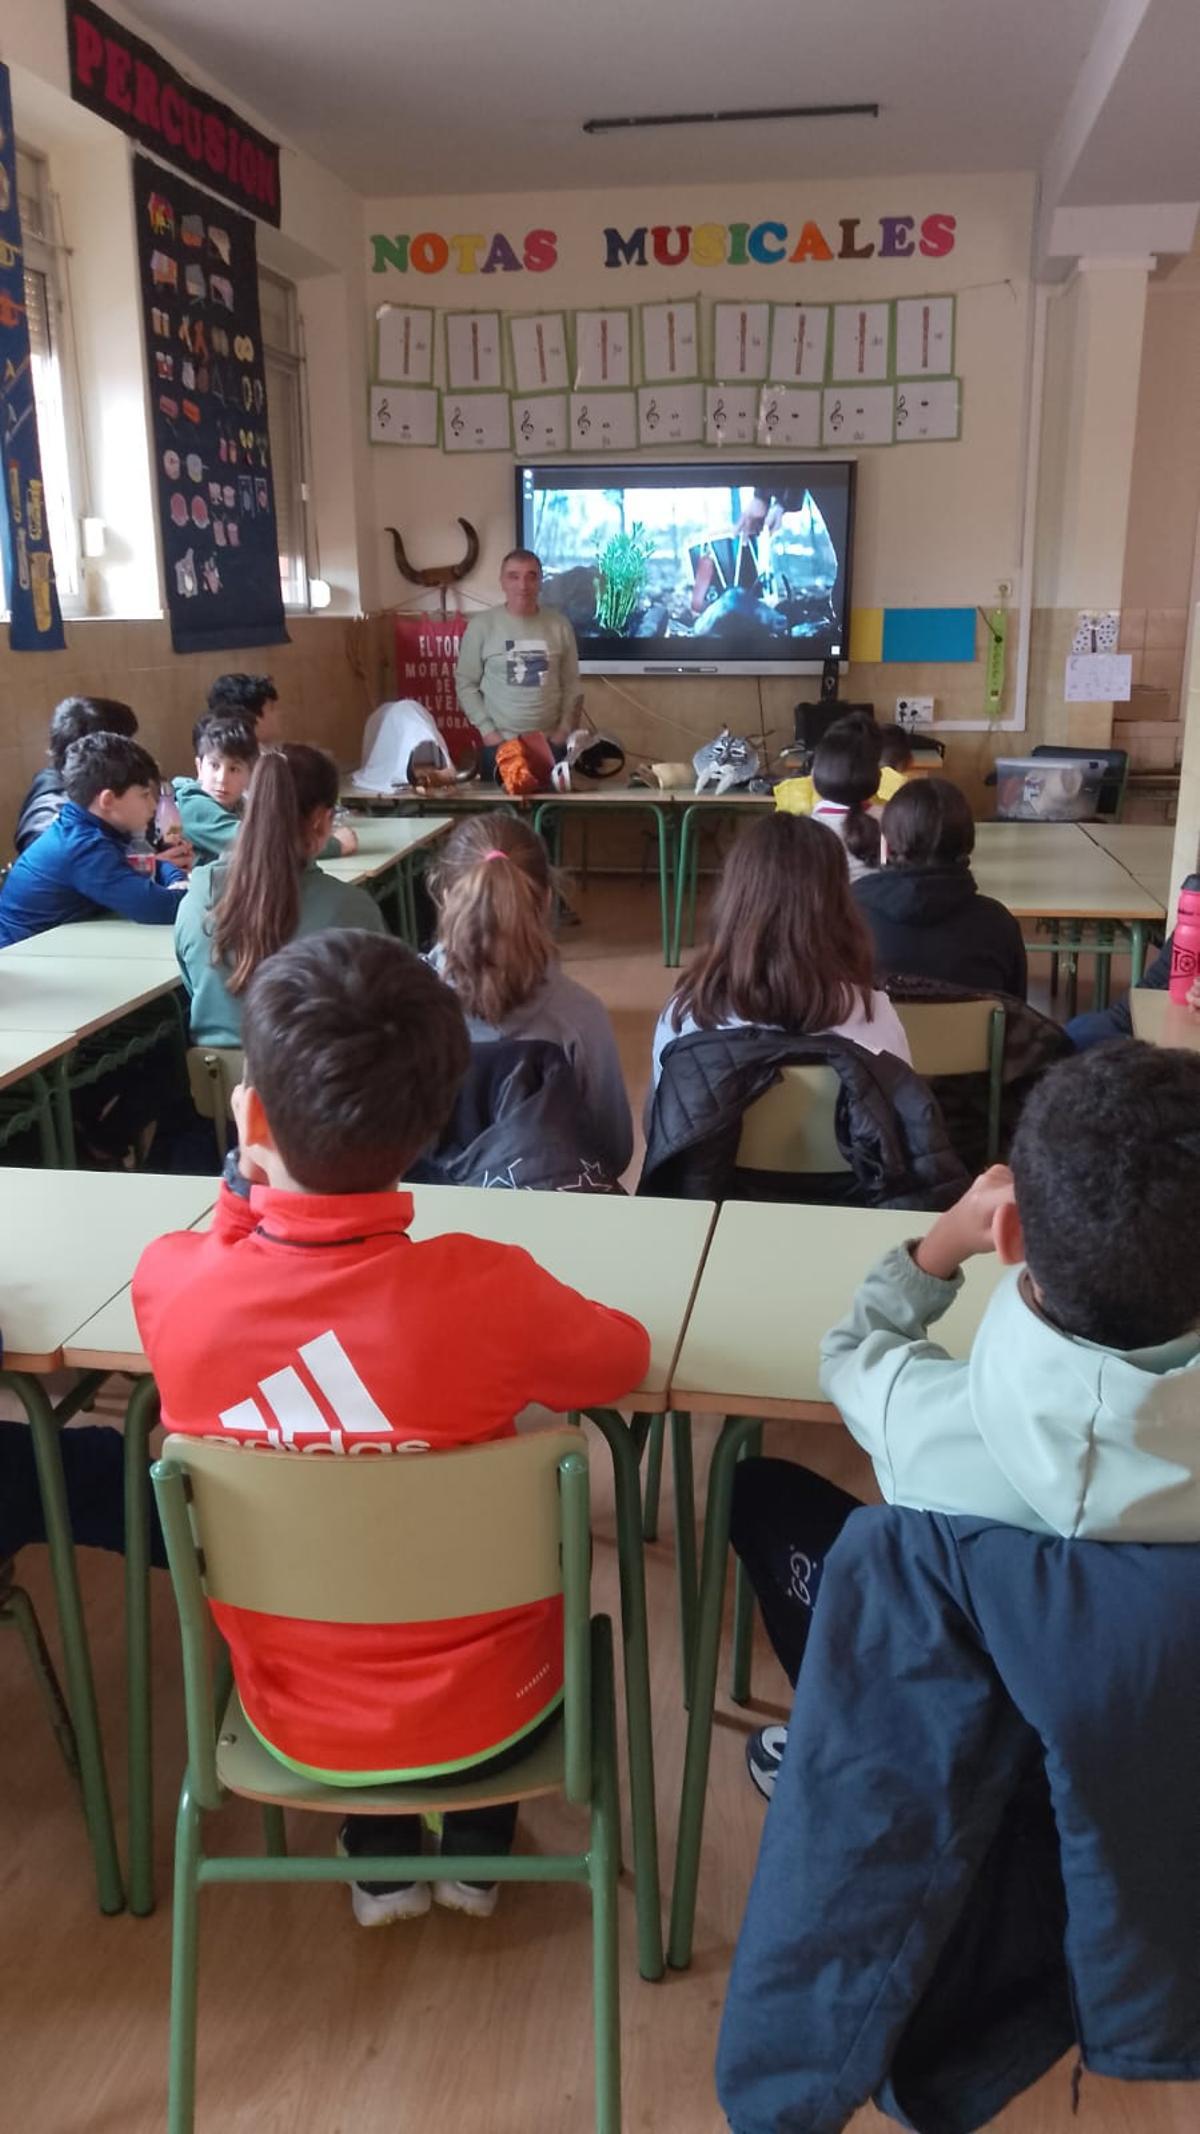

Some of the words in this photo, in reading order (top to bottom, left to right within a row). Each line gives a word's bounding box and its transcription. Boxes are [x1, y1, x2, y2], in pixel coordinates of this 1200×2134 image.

[75, 15, 275, 207] PERCUSION
[371, 229, 557, 274] NOTAS
[604, 214, 957, 267] MUSICALES
[419, 635, 433, 657] EL
